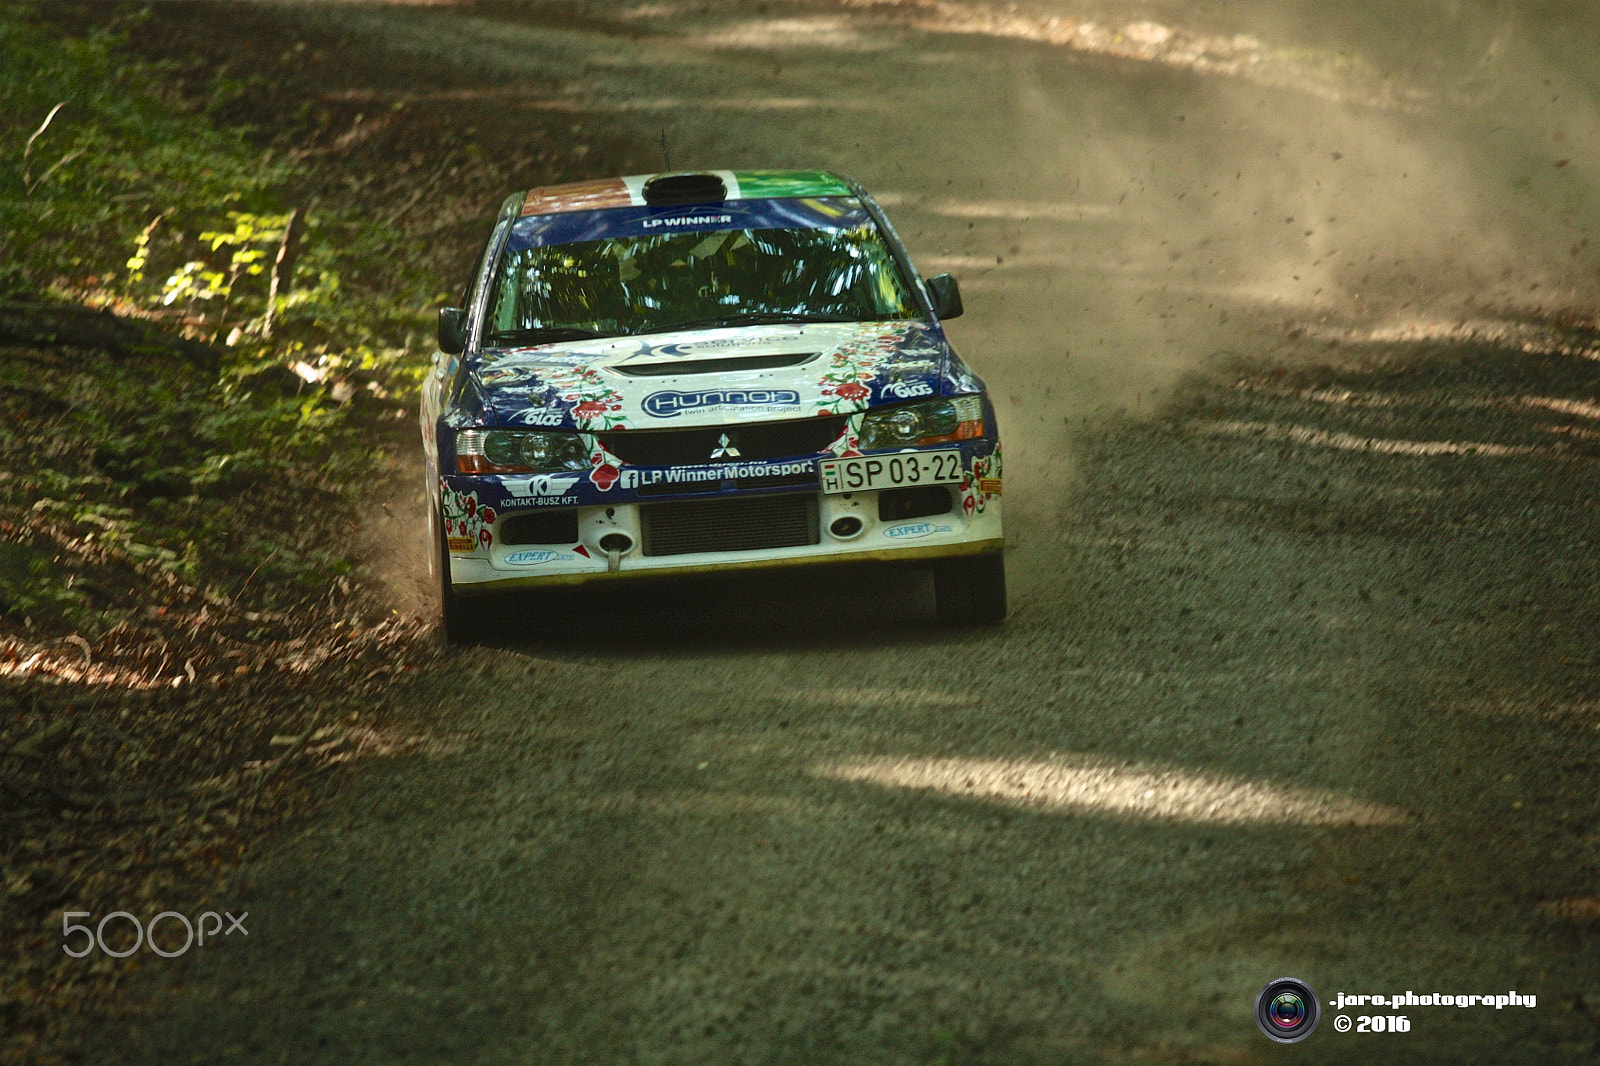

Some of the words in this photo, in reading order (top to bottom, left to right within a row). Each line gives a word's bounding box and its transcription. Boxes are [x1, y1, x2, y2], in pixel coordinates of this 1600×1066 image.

[684, 408, 705, 416] twin
[767, 405, 802, 413] project
[846, 460, 883, 488] SP
[889, 454, 960, 484] 03-22
[826, 478, 839, 490] H
[500, 496, 560, 508] KONTAKT-BUSZ
[890, 523, 931, 537] EXPERT
[508, 551, 556, 562] EXPERT
